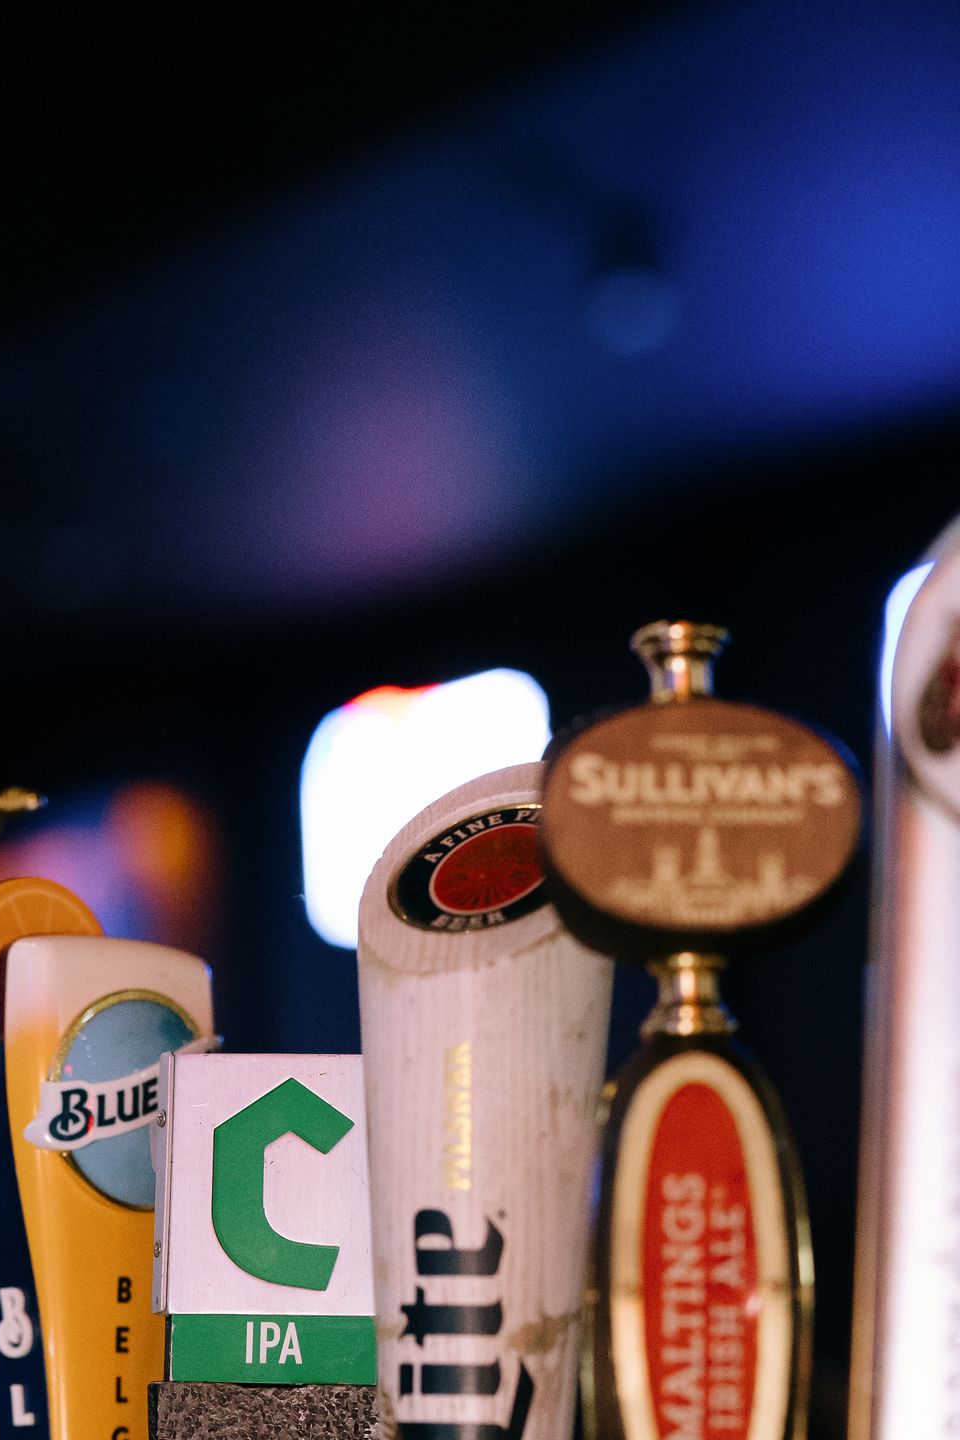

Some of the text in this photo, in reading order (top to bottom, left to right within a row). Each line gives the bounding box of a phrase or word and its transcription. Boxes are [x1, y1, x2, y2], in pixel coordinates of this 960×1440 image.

[570, 753, 842, 805] SULLIVAN'S
[440, 814, 503, 848] FINE
[49, 1077, 159, 1142] BLUE
[245, 1321, 303, 1365] IPA
